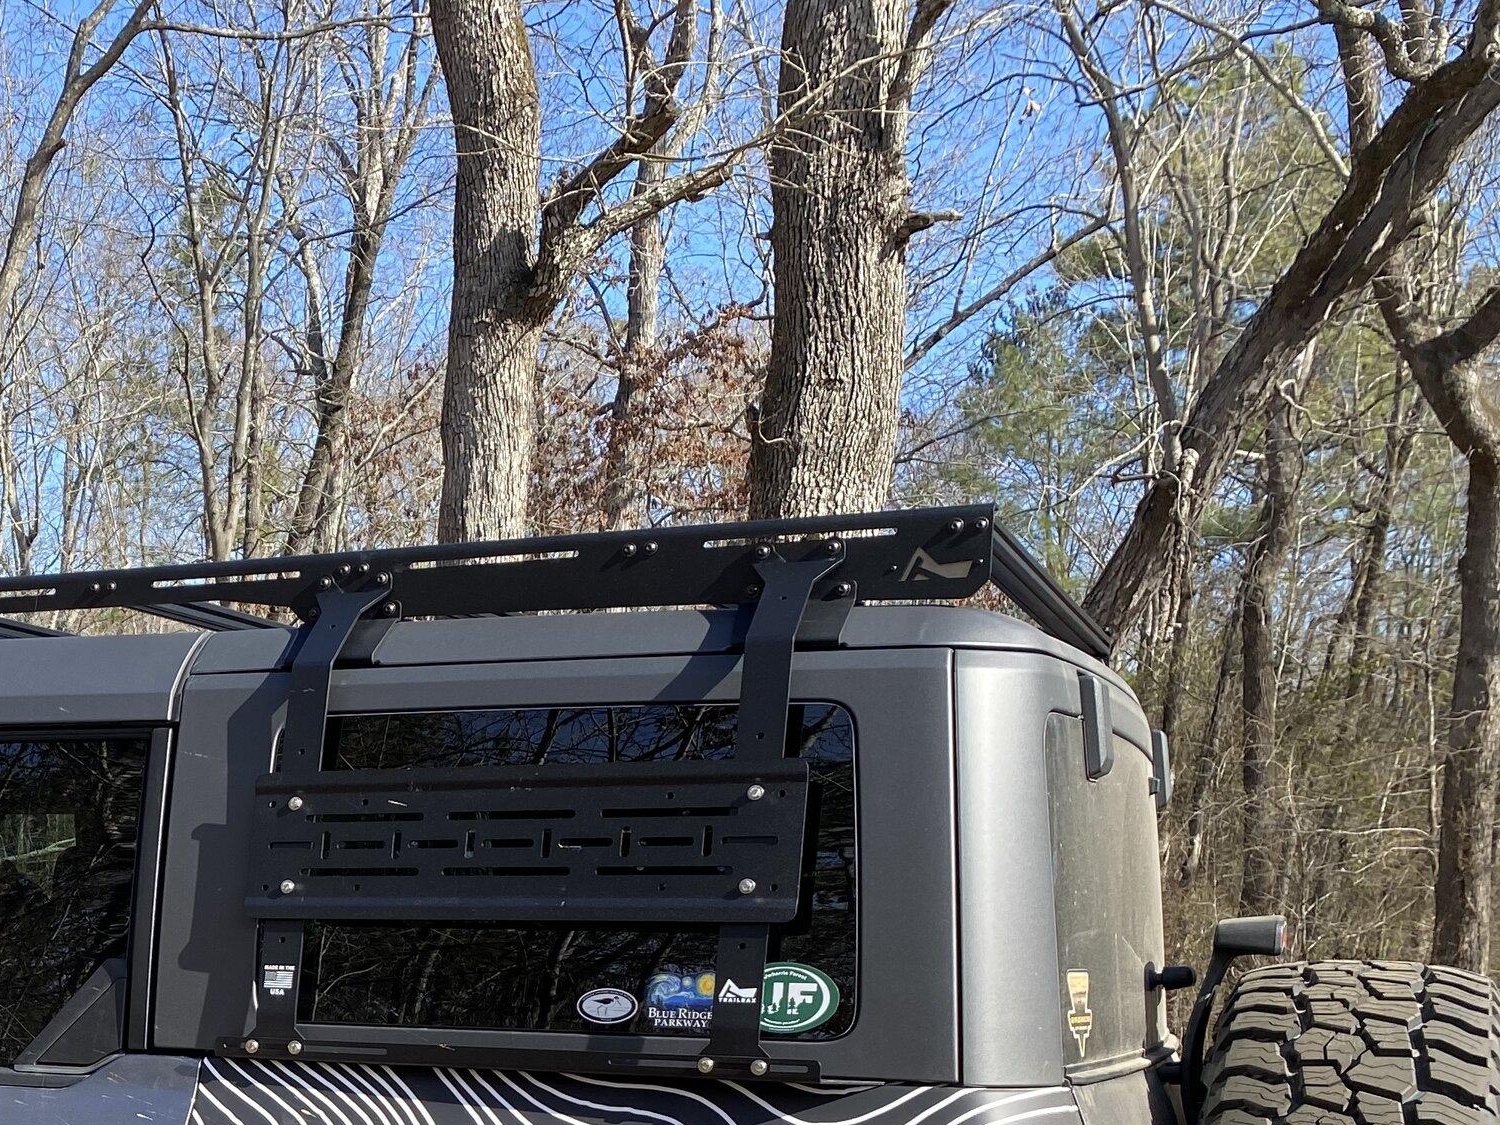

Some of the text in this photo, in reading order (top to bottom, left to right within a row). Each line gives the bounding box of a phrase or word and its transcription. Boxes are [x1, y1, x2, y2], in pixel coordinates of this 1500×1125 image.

[648, 1006, 713, 1020] BLUE RIDGE
[654, 1018, 708, 1028] PARKWAY
